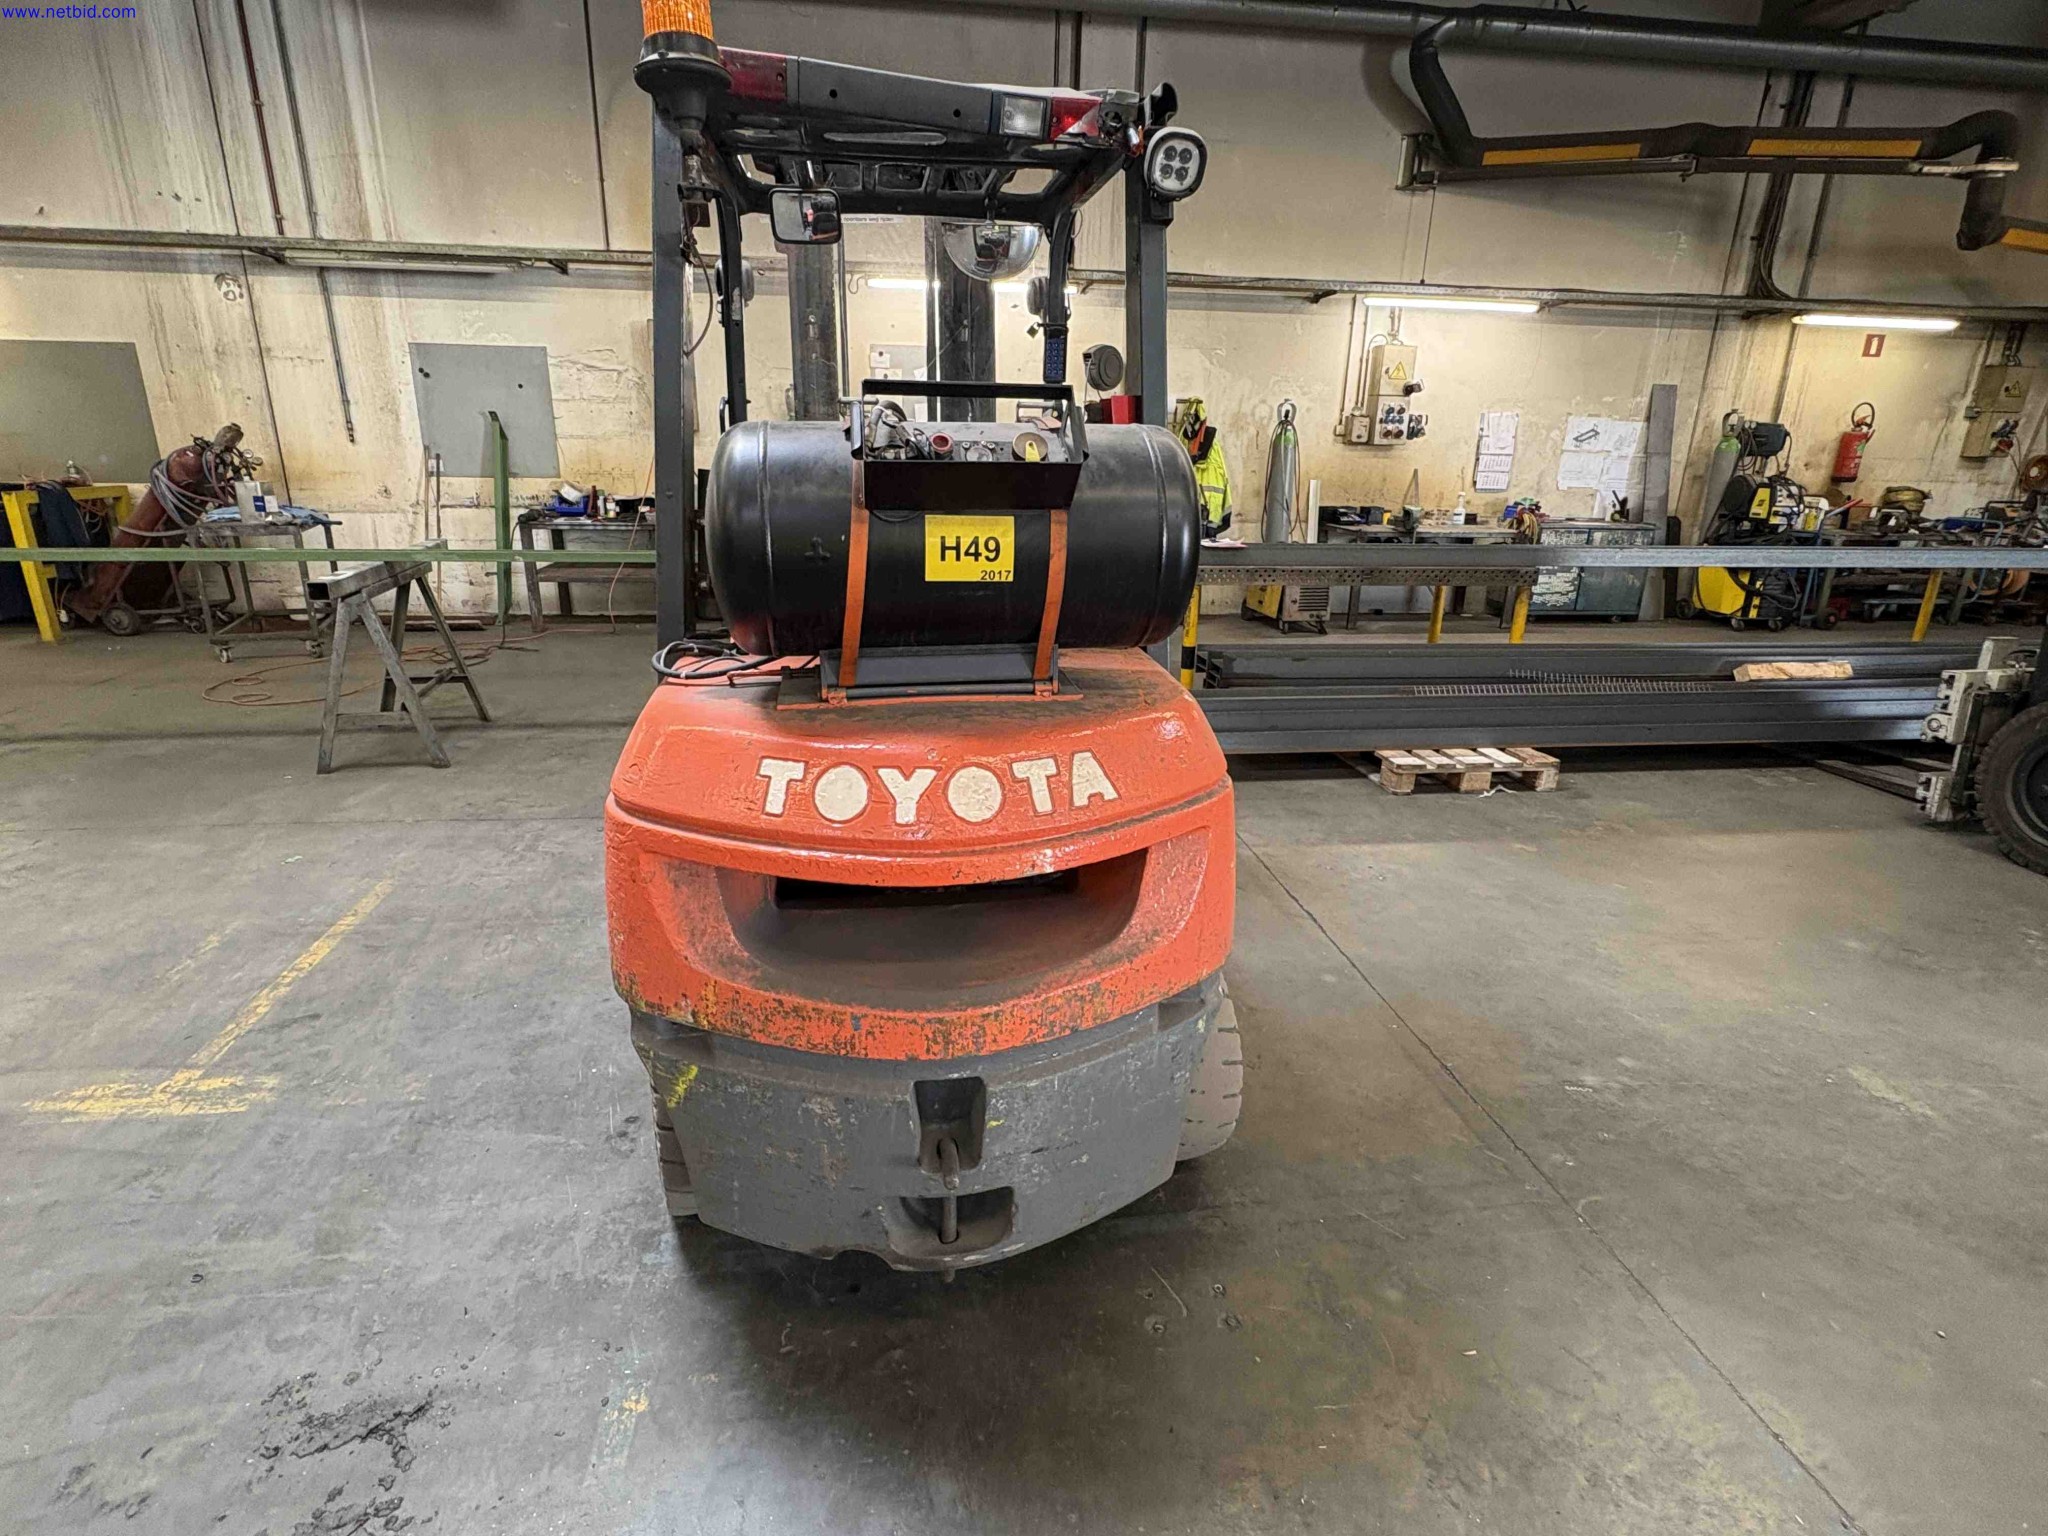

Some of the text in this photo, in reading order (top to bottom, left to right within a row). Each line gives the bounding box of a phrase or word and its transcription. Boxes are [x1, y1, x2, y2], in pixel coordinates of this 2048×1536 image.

[940, 535, 1001, 563] H49
[980, 569, 1012, 581] 2017
[756, 751, 1121, 826] TOYOTA
